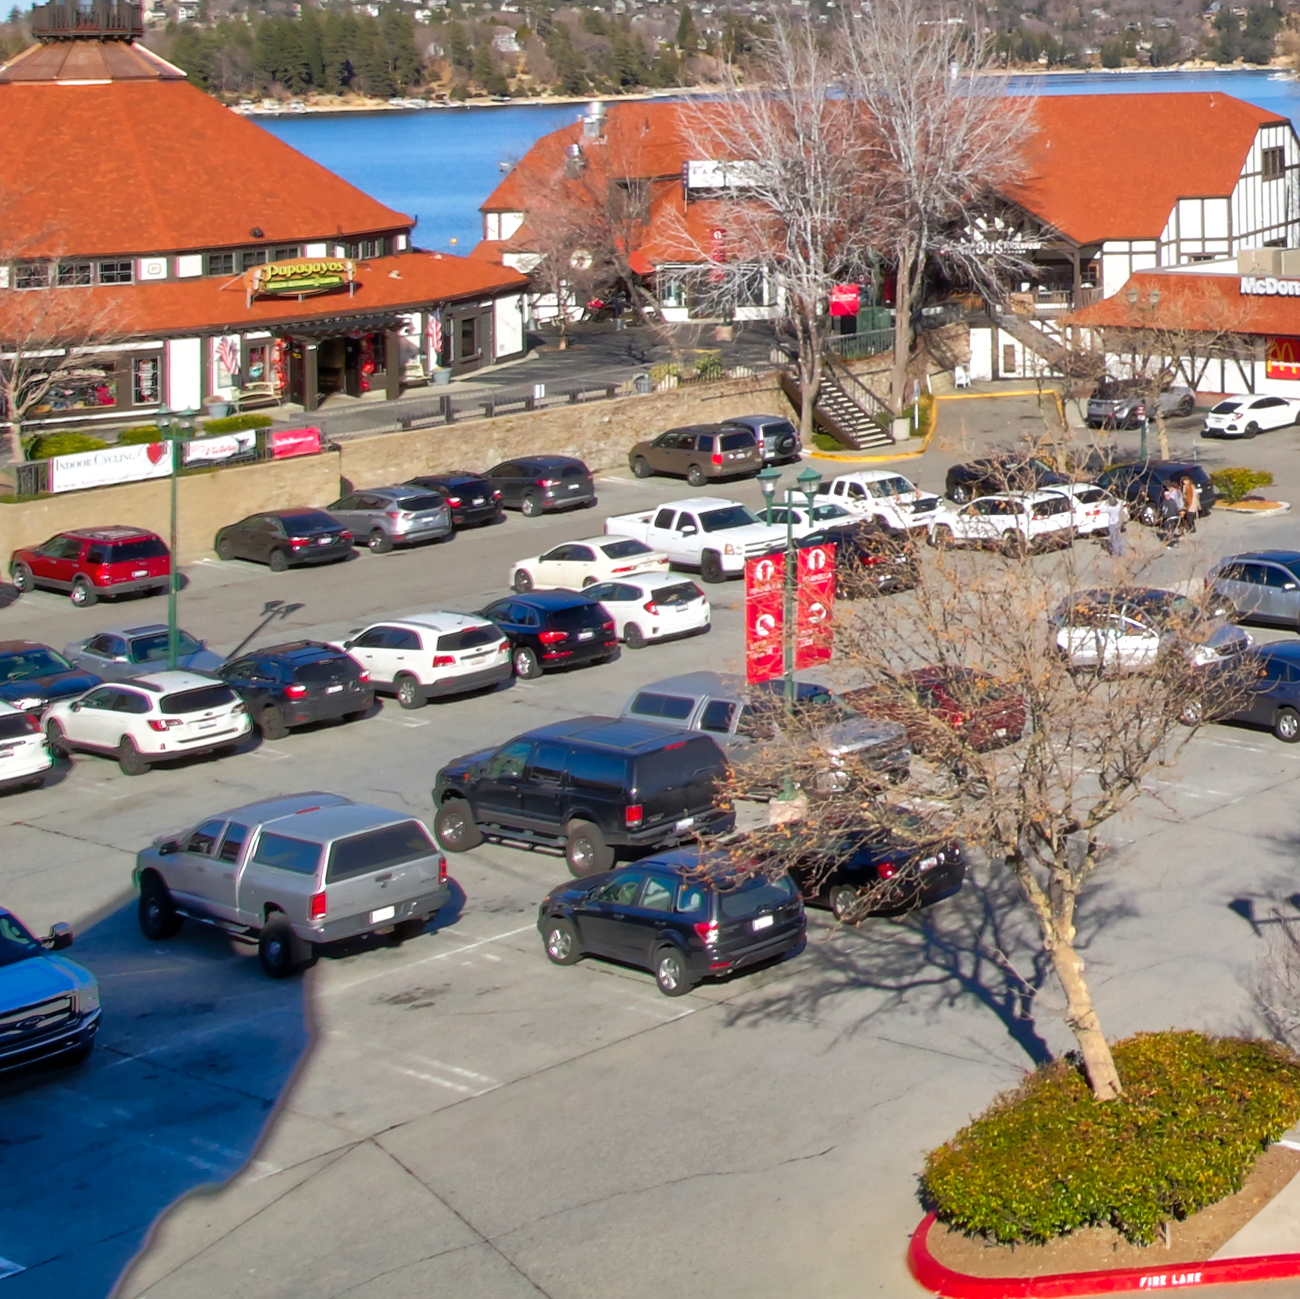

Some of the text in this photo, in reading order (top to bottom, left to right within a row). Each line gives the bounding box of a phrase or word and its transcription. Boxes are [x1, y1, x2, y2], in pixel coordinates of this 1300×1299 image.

[264, 261, 344, 281] Papagayos
[56, 458, 92, 471] INDOOR
[1140, 1272, 1201, 1288] FIRE LANE
